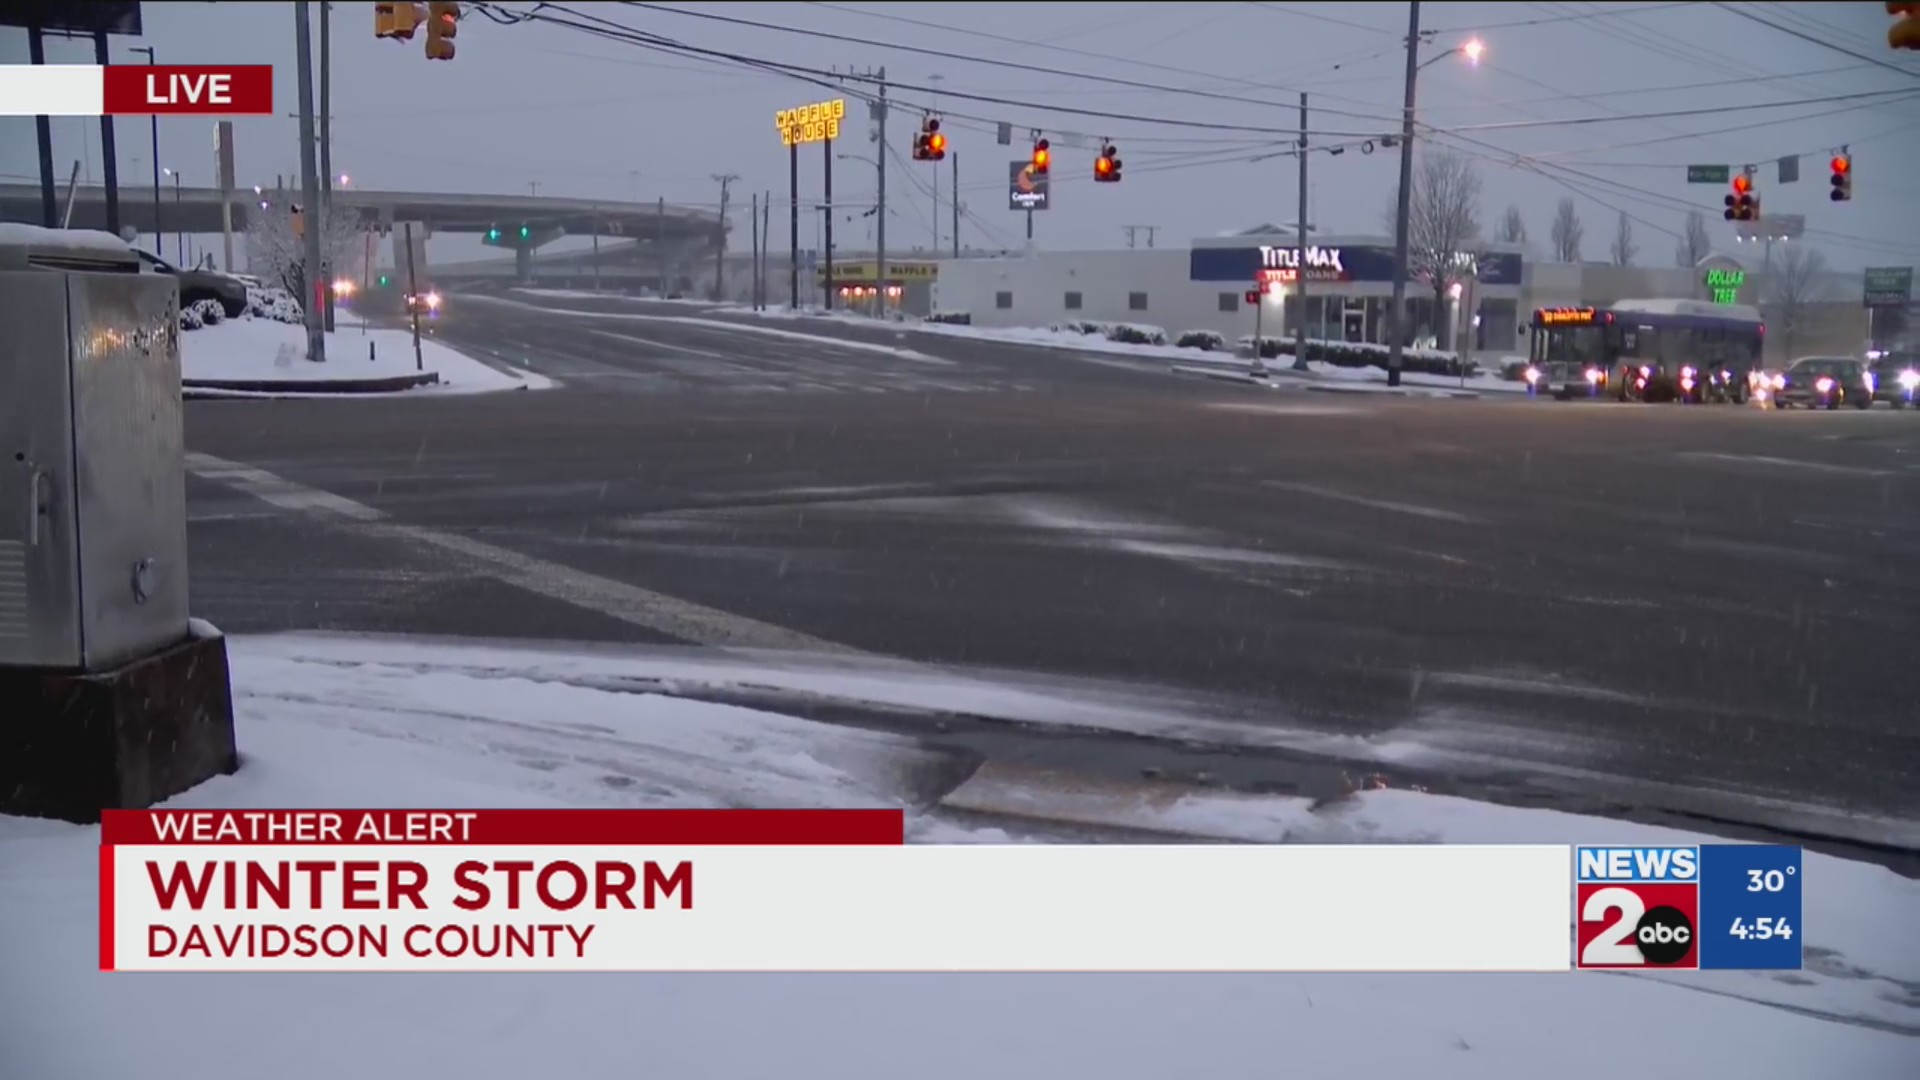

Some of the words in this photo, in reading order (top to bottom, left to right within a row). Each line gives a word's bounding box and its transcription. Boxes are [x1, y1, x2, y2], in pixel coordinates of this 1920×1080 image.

[777, 101, 843, 127] WAFFLE
[782, 120, 837, 143] HOUSE
[1012, 191, 1045, 201] Comfort
[1708, 270, 1743, 286] DOLLAR
[1715, 288, 1736, 304] TREE
